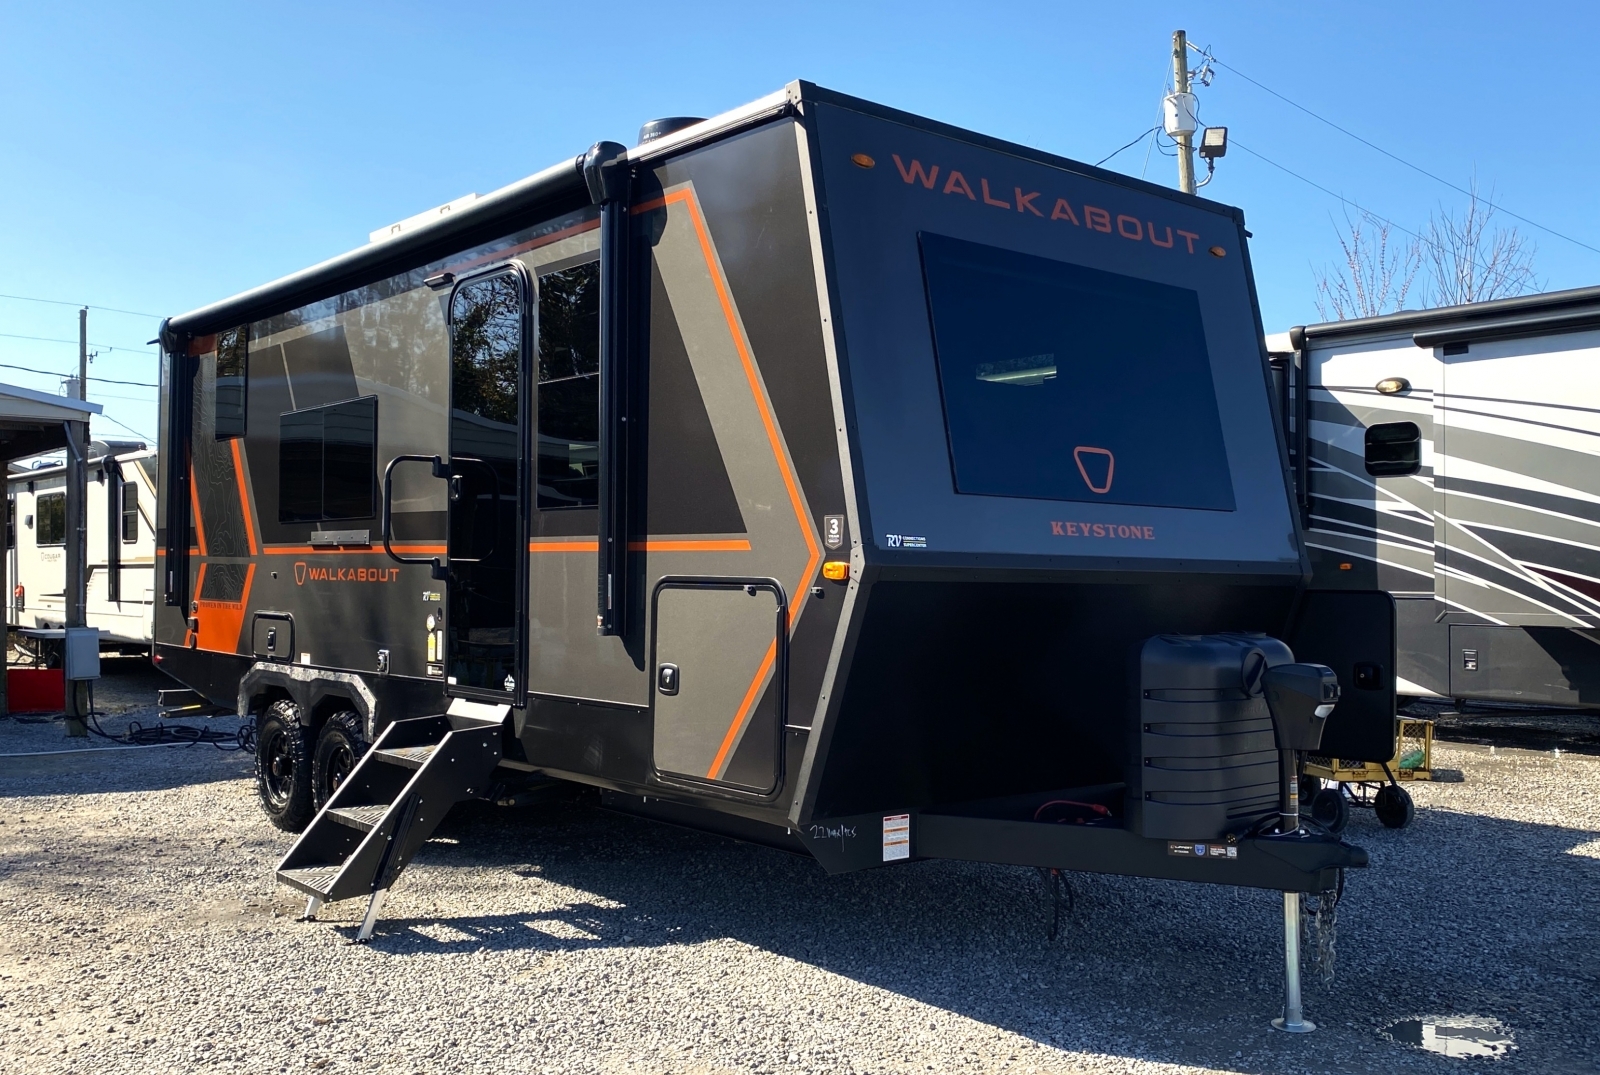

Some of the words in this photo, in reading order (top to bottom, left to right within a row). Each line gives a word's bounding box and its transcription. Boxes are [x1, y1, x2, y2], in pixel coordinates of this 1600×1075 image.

[891, 153, 1201, 254] WALKABOUT
[829, 518, 839, 535] 3
[1050, 521, 1156, 540] KEYSTONE
[886, 534, 902, 548] RV
[308, 567, 400, 582] WALKABOUT
